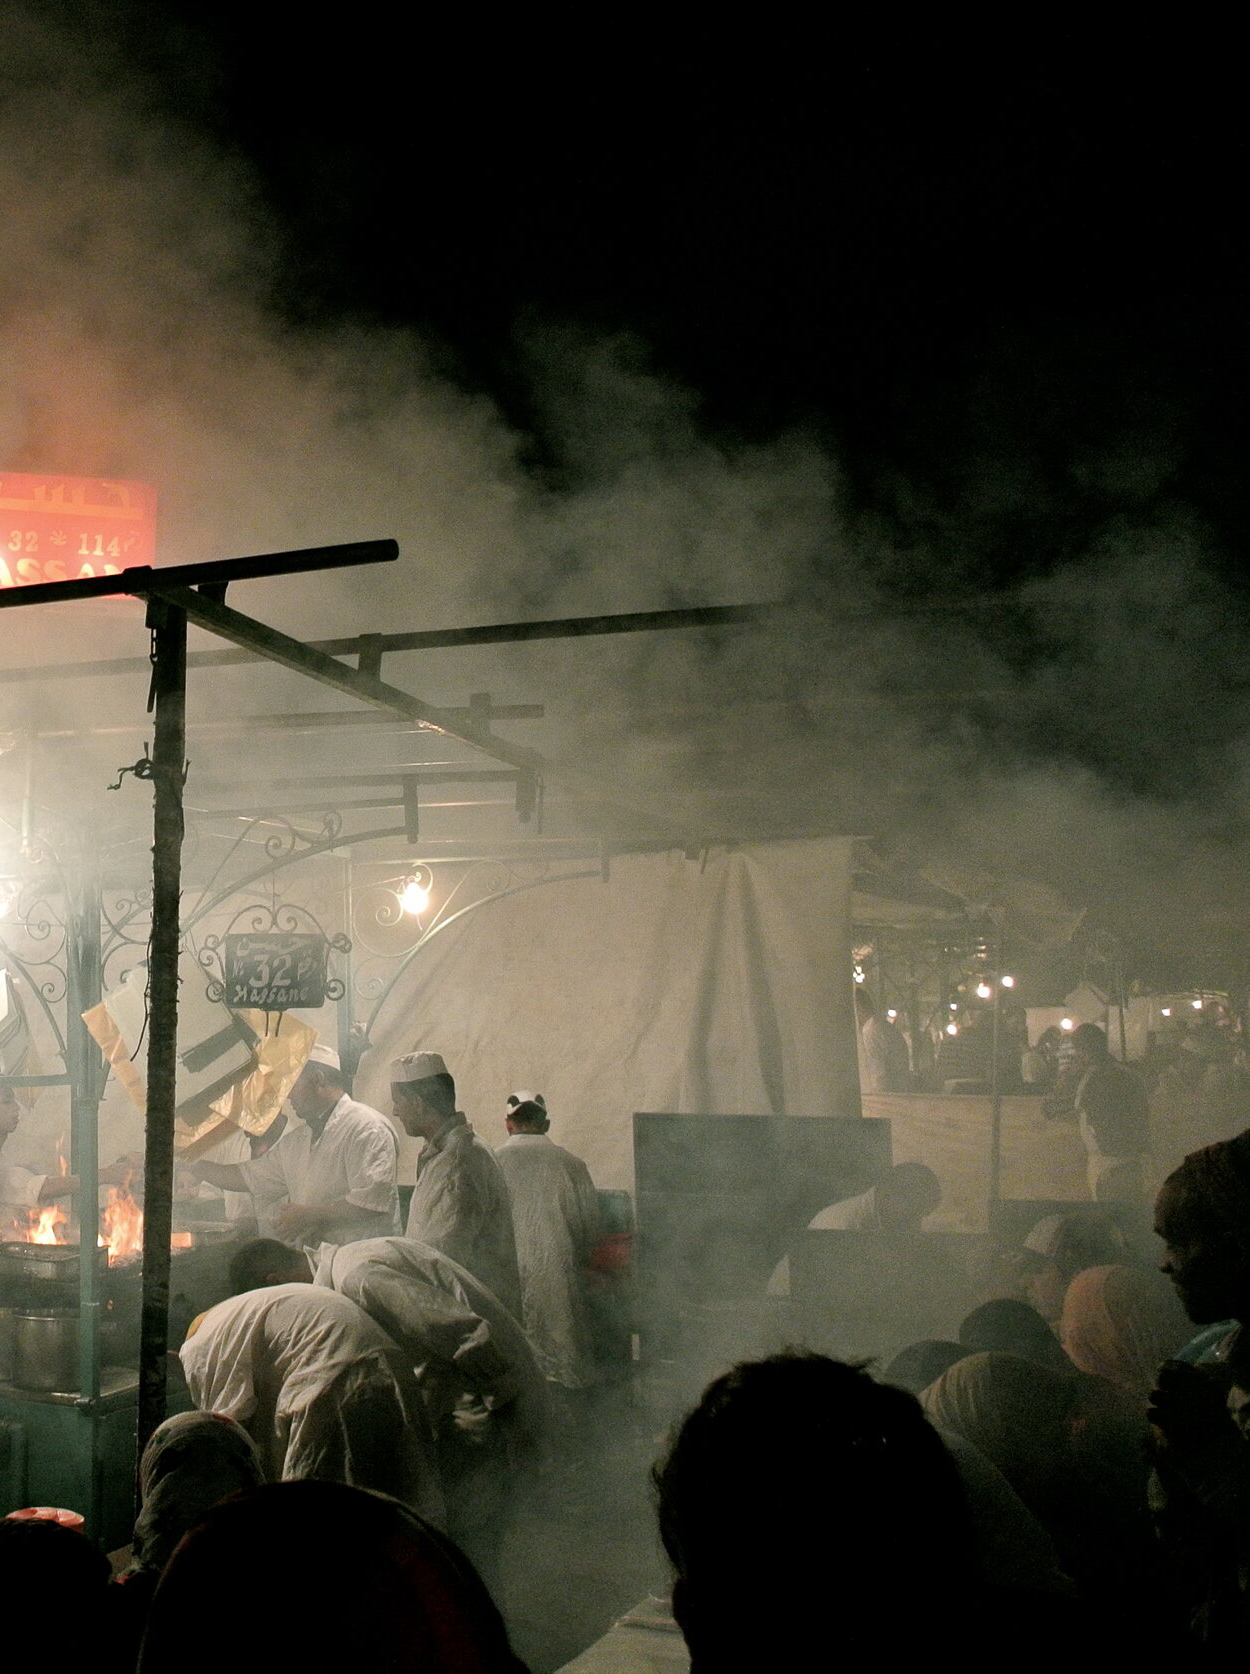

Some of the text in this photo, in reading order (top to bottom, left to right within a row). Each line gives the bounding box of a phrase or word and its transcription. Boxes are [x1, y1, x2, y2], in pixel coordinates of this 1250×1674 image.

[8, 530, 39, 552] 32
[77, 532, 121, 557] 114
[248, 954, 292, 987] 32
[233, 984, 309, 1004] Hassane
